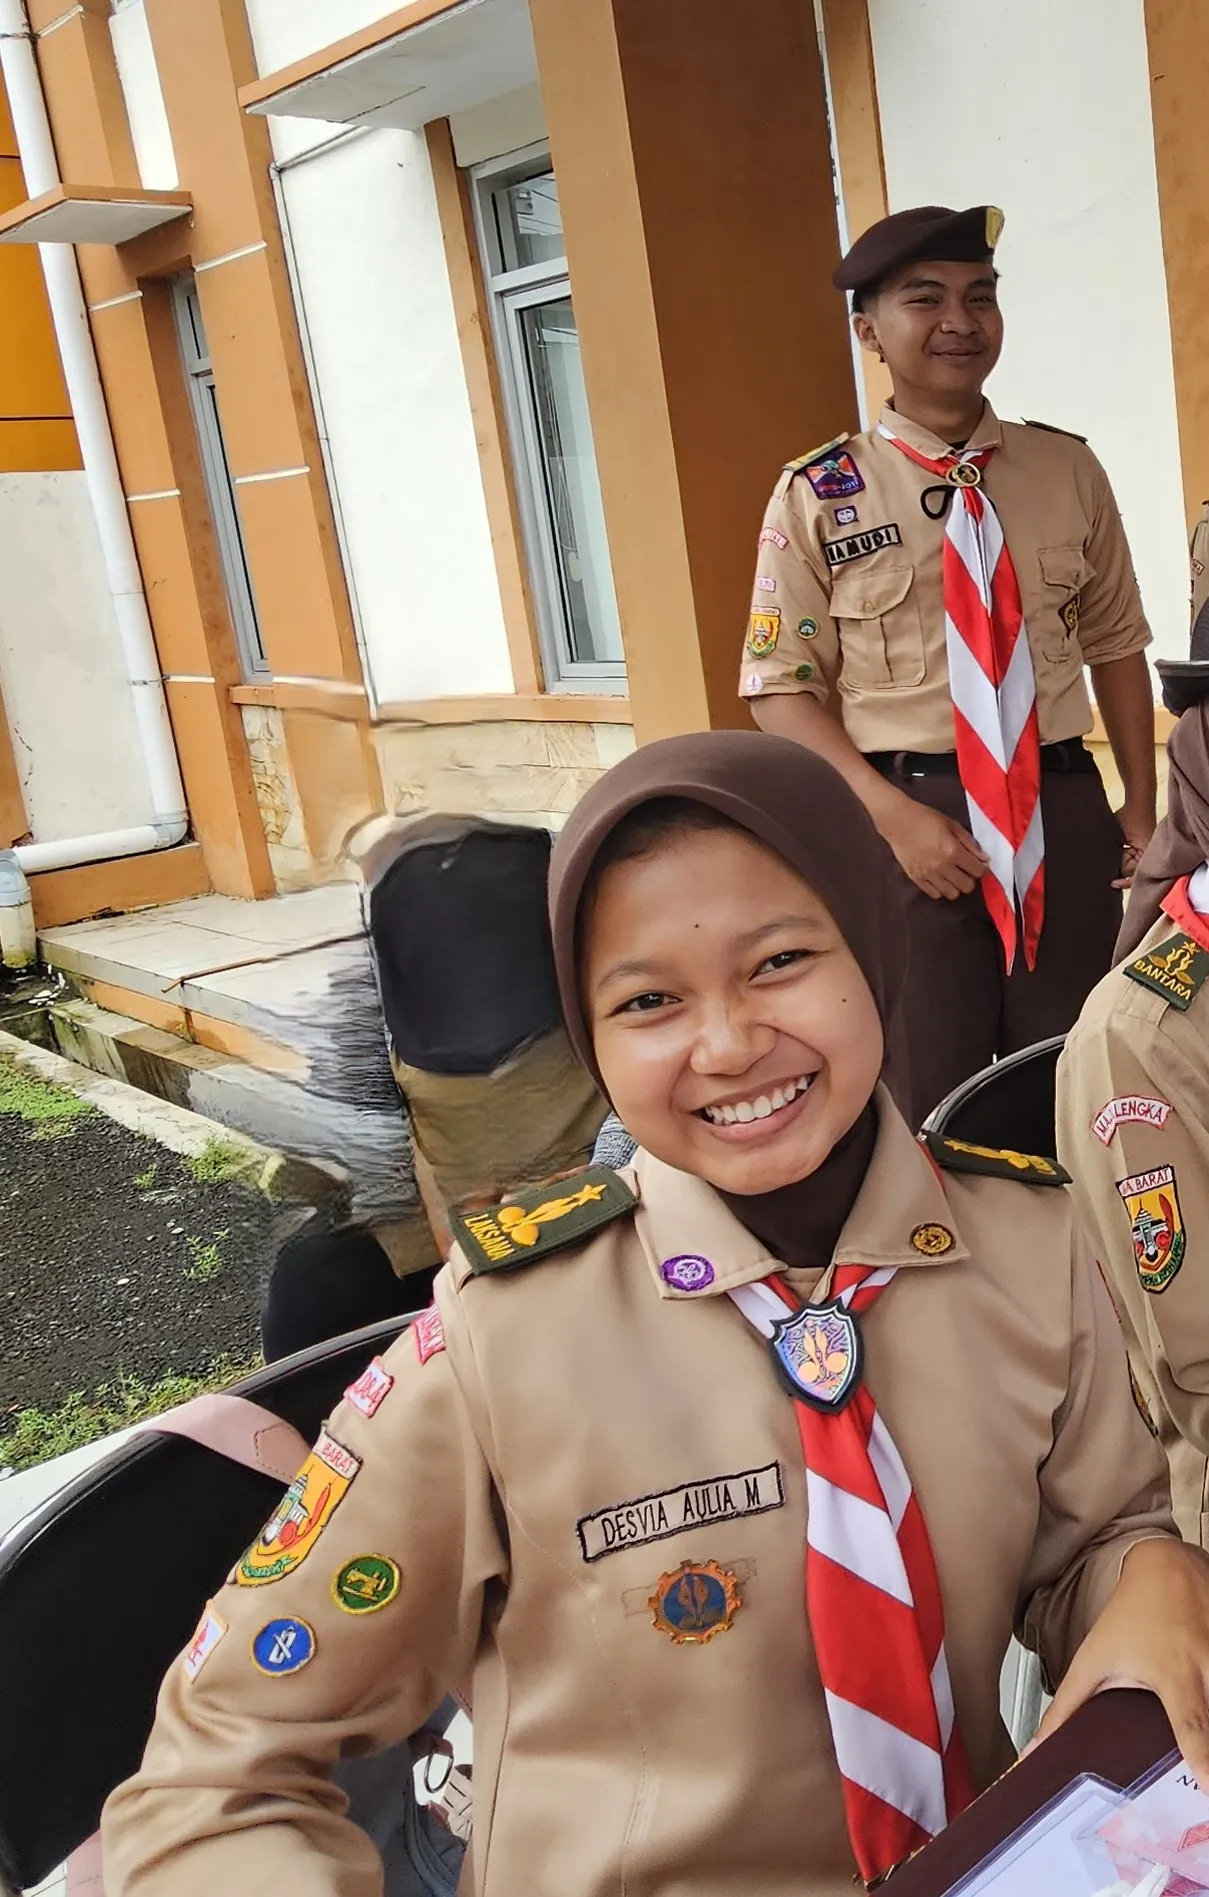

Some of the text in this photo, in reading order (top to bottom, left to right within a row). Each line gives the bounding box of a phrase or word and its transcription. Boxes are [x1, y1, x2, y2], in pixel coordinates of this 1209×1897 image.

[1134, 958, 1191, 1001] BANTARA
[1097, 1101, 1164, 1136] MALENGKA
[1136, 1169, 1169, 1191] BARAT
[464, 1213, 515, 1261] LAKSANA
[323, 1442, 354, 1474] BARAT
[601, 1478, 761, 1547] DESVIA AULIA M
